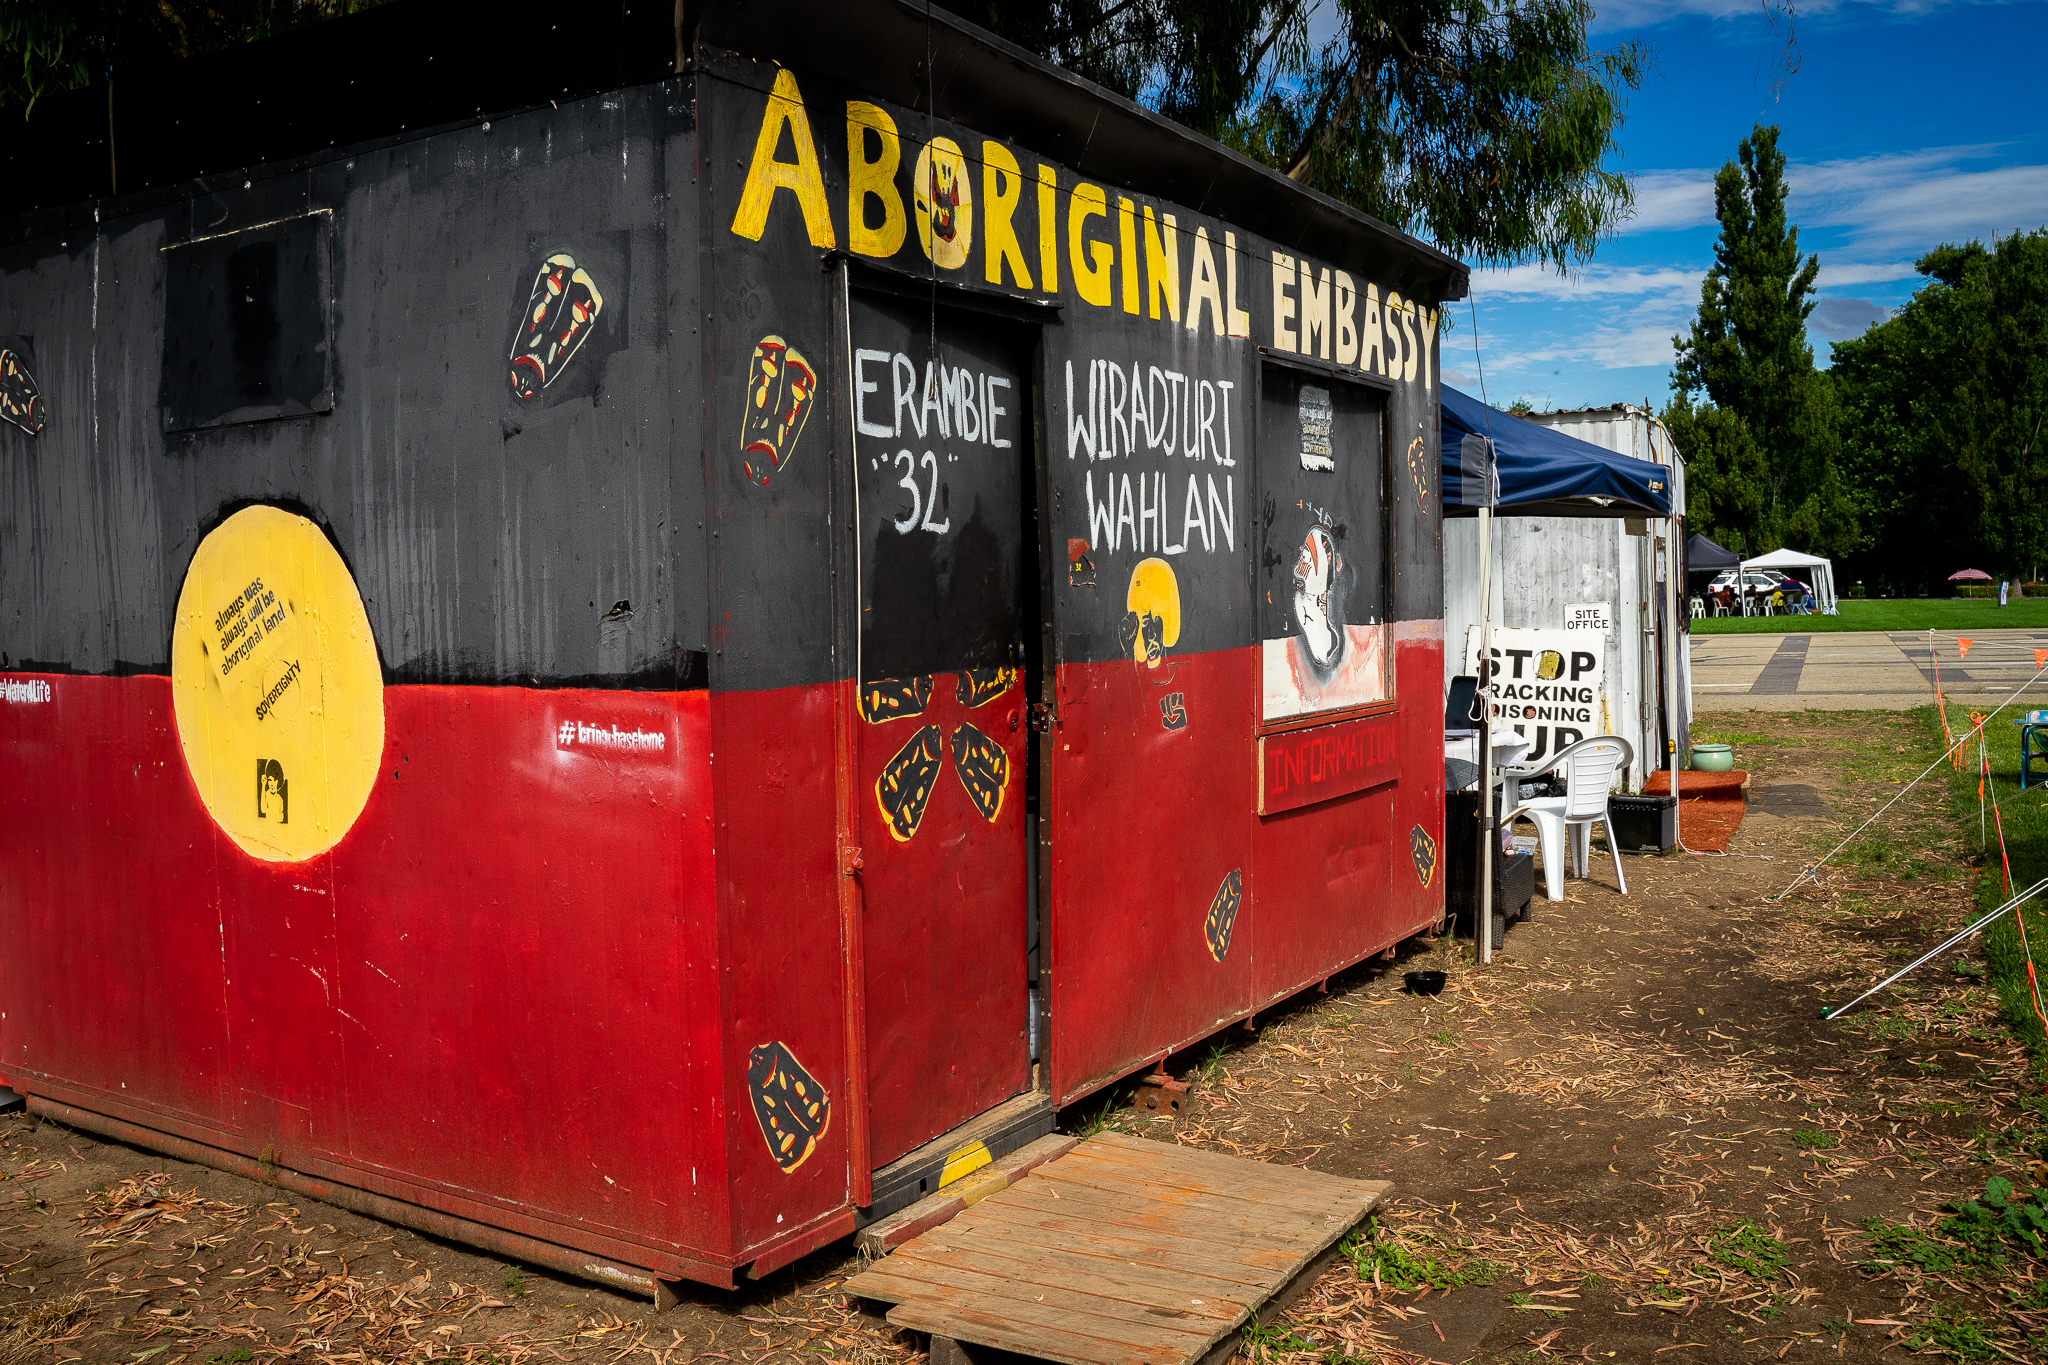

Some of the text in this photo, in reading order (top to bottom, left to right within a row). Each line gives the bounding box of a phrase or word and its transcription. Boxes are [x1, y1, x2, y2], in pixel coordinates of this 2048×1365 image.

[731, 68, 1438, 390] ABORIGINAL EMBASSY
[855, 348, 1012, 448] ERAMBIE
[1066, 359, 1236, 467] WIRADJURI
[1086, 470, 1235, 555] WAHLAN
[215, 577, 264, 632] always was
[221, 590, 275, 651] always will be
[1567, 620, 1609, 630] OFFICE
[1575, 609, 1600, 619] SITE
[221, 601, 286, 676] aboriginal land
[1476, 647, 1596, 681] STOP
[256, 660, 301, 721] SOVEREIGNTY
[1491, 683, 1593, 704] RACKING
[1491, 704, 1591, 722] OISONING
[1269, 723, 1396, 796] INFORMATION
